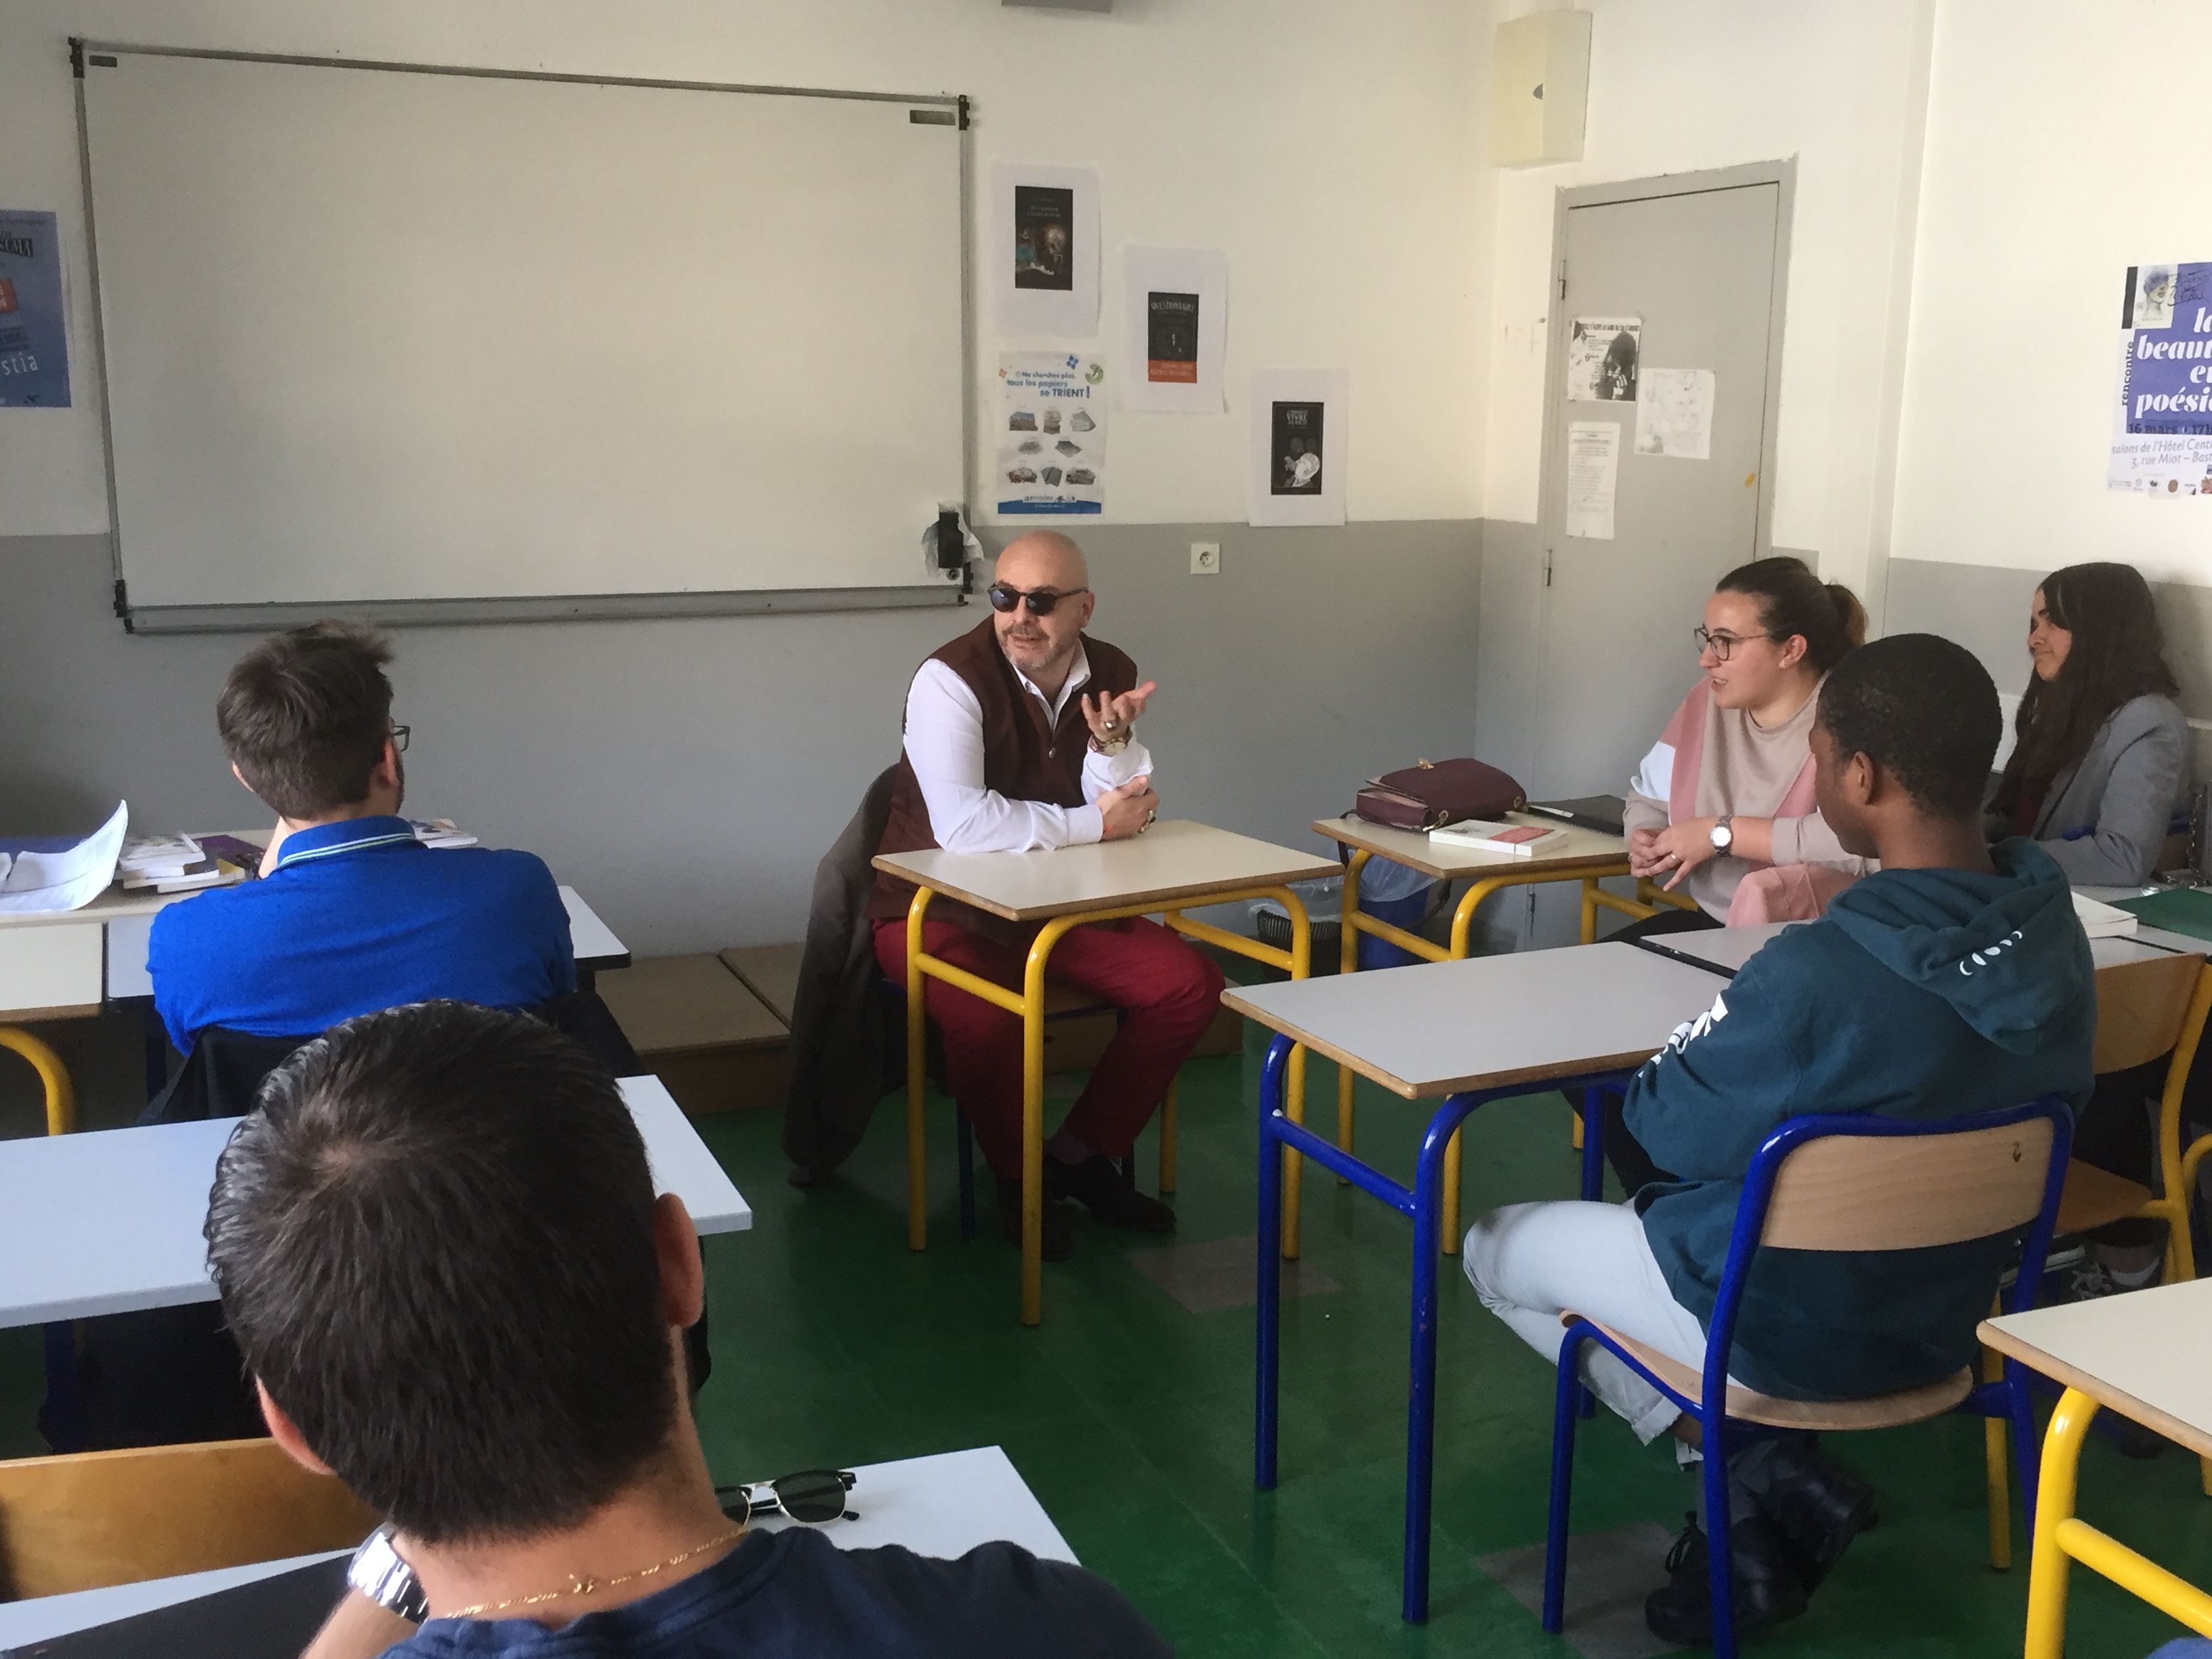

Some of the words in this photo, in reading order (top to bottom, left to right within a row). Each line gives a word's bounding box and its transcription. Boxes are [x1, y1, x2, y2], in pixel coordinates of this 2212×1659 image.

[0, 352, 38, 375] stia
[2122, 342, 2133, 405] rencontre
[1052, 388, 1084, 397] TRIENT
[2135, 387, 2212, 418] poési
[2129, 423, 2142, 434] 16
[2145, 425, 2177, 434] mars
[2112, 443, 2138, 454] salons
[2141, 442, 2151, 453] de
[2142, 457, 2156, 465] rue
[2158, 453, 2181, 464] Miot
